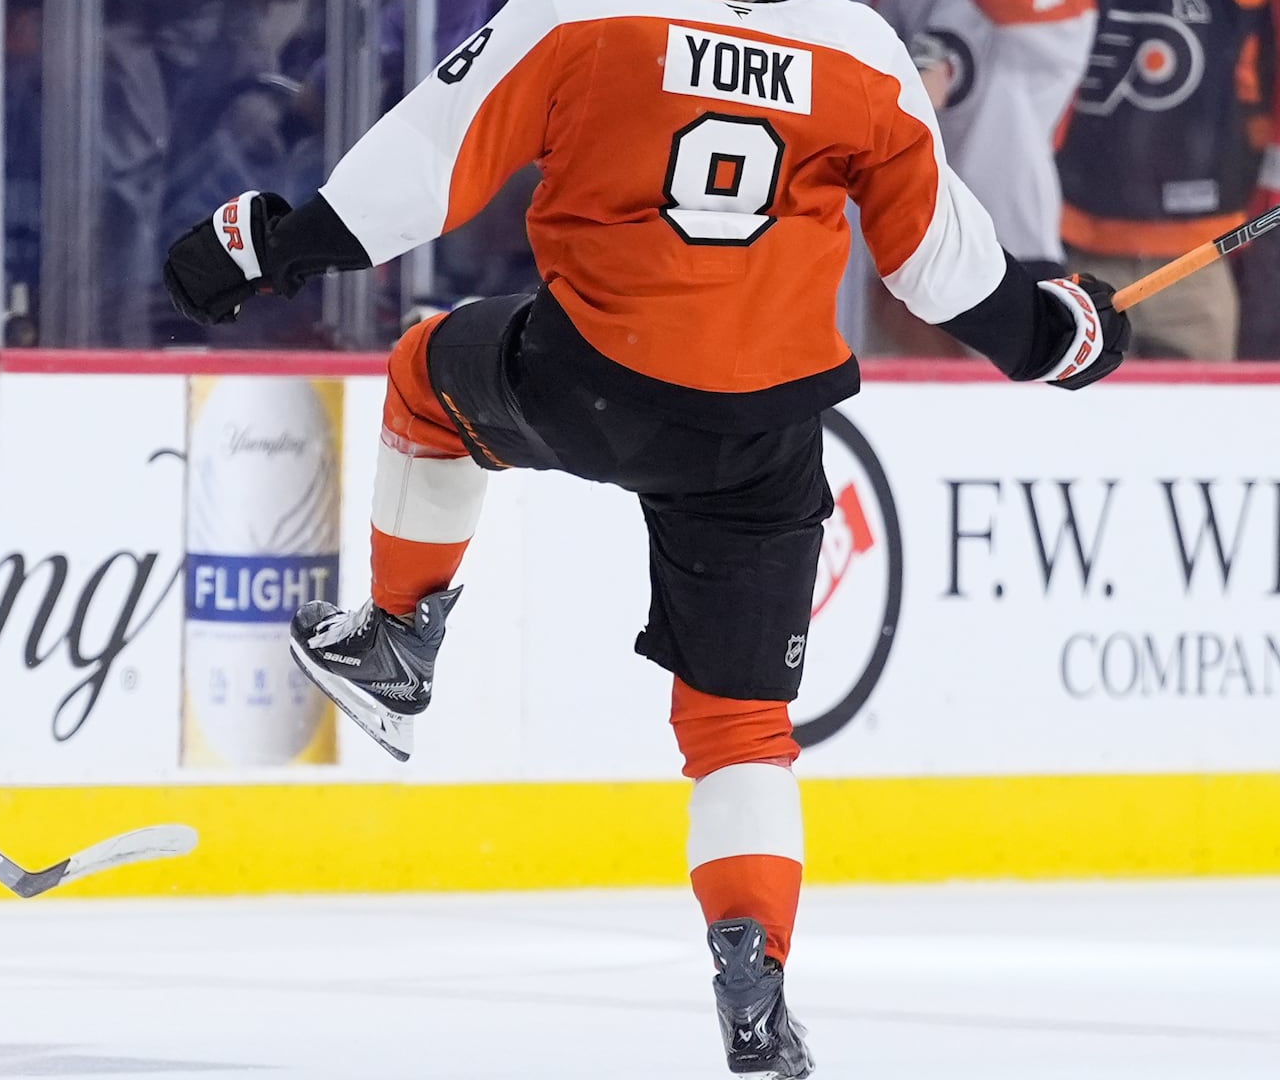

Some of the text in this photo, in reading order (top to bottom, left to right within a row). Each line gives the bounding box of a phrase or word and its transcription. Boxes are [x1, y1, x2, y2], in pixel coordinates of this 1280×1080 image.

[436, 27, 494, 85] 8
[685, 34, 796, 105] YORK
[659, 110, 786, 247] 8
[939, 478, 1120, 598] F.W.
[194, 563, 330, 613] FLIGHT
